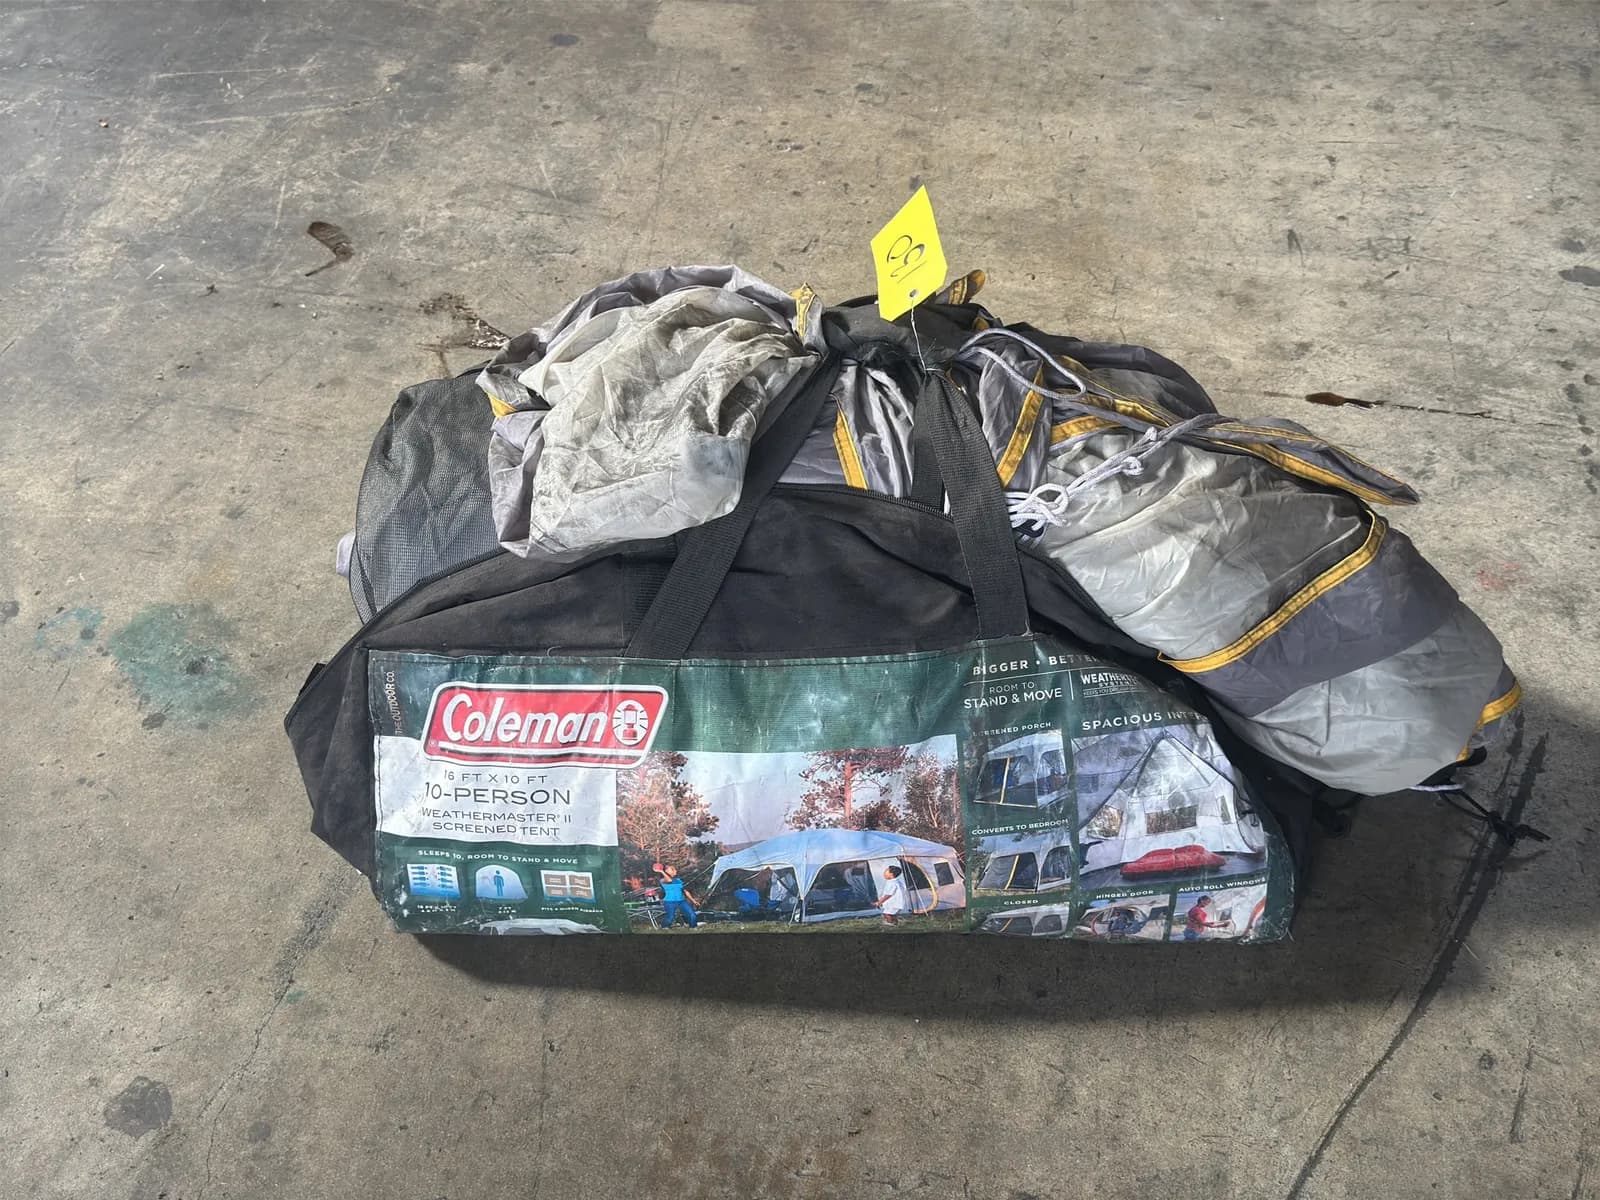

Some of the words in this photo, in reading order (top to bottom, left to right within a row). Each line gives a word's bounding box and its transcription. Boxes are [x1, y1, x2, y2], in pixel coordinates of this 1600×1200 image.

[973, 660, 1029, 676] BIGGER
[989, 683, 1018, 694] ROOM
[1022, 681, 1035, 690] TO
[385, 683, 401, 721] OUTDOOR
[963, 695, 1008, 709] STAND
[1011, 693, 1020, 703] &
[1023, 687, 1063, 702] MOVE
[442, 693, 608, 744] Coleman
[1021, 721, 1052, 731] PORCH
[1082, 712, 1162, 730] SPACIOUS
[444, 769, 455, 781] 16
[461, 773, 482, 782] FT
[504, 775, 520, 784] 10
[527, 775, 548, 784] FT
[425, 782, 570, 805] 10-PERSON
[432, 822, 517, 834] SCREENED
[520, 827, 560, 837] TENT
[971, 825, 1015, 835] CONVERTS
[1029, 818, 1069, 829] BEDROOM
[1226, 877, 1267, 888] WINDOWS
